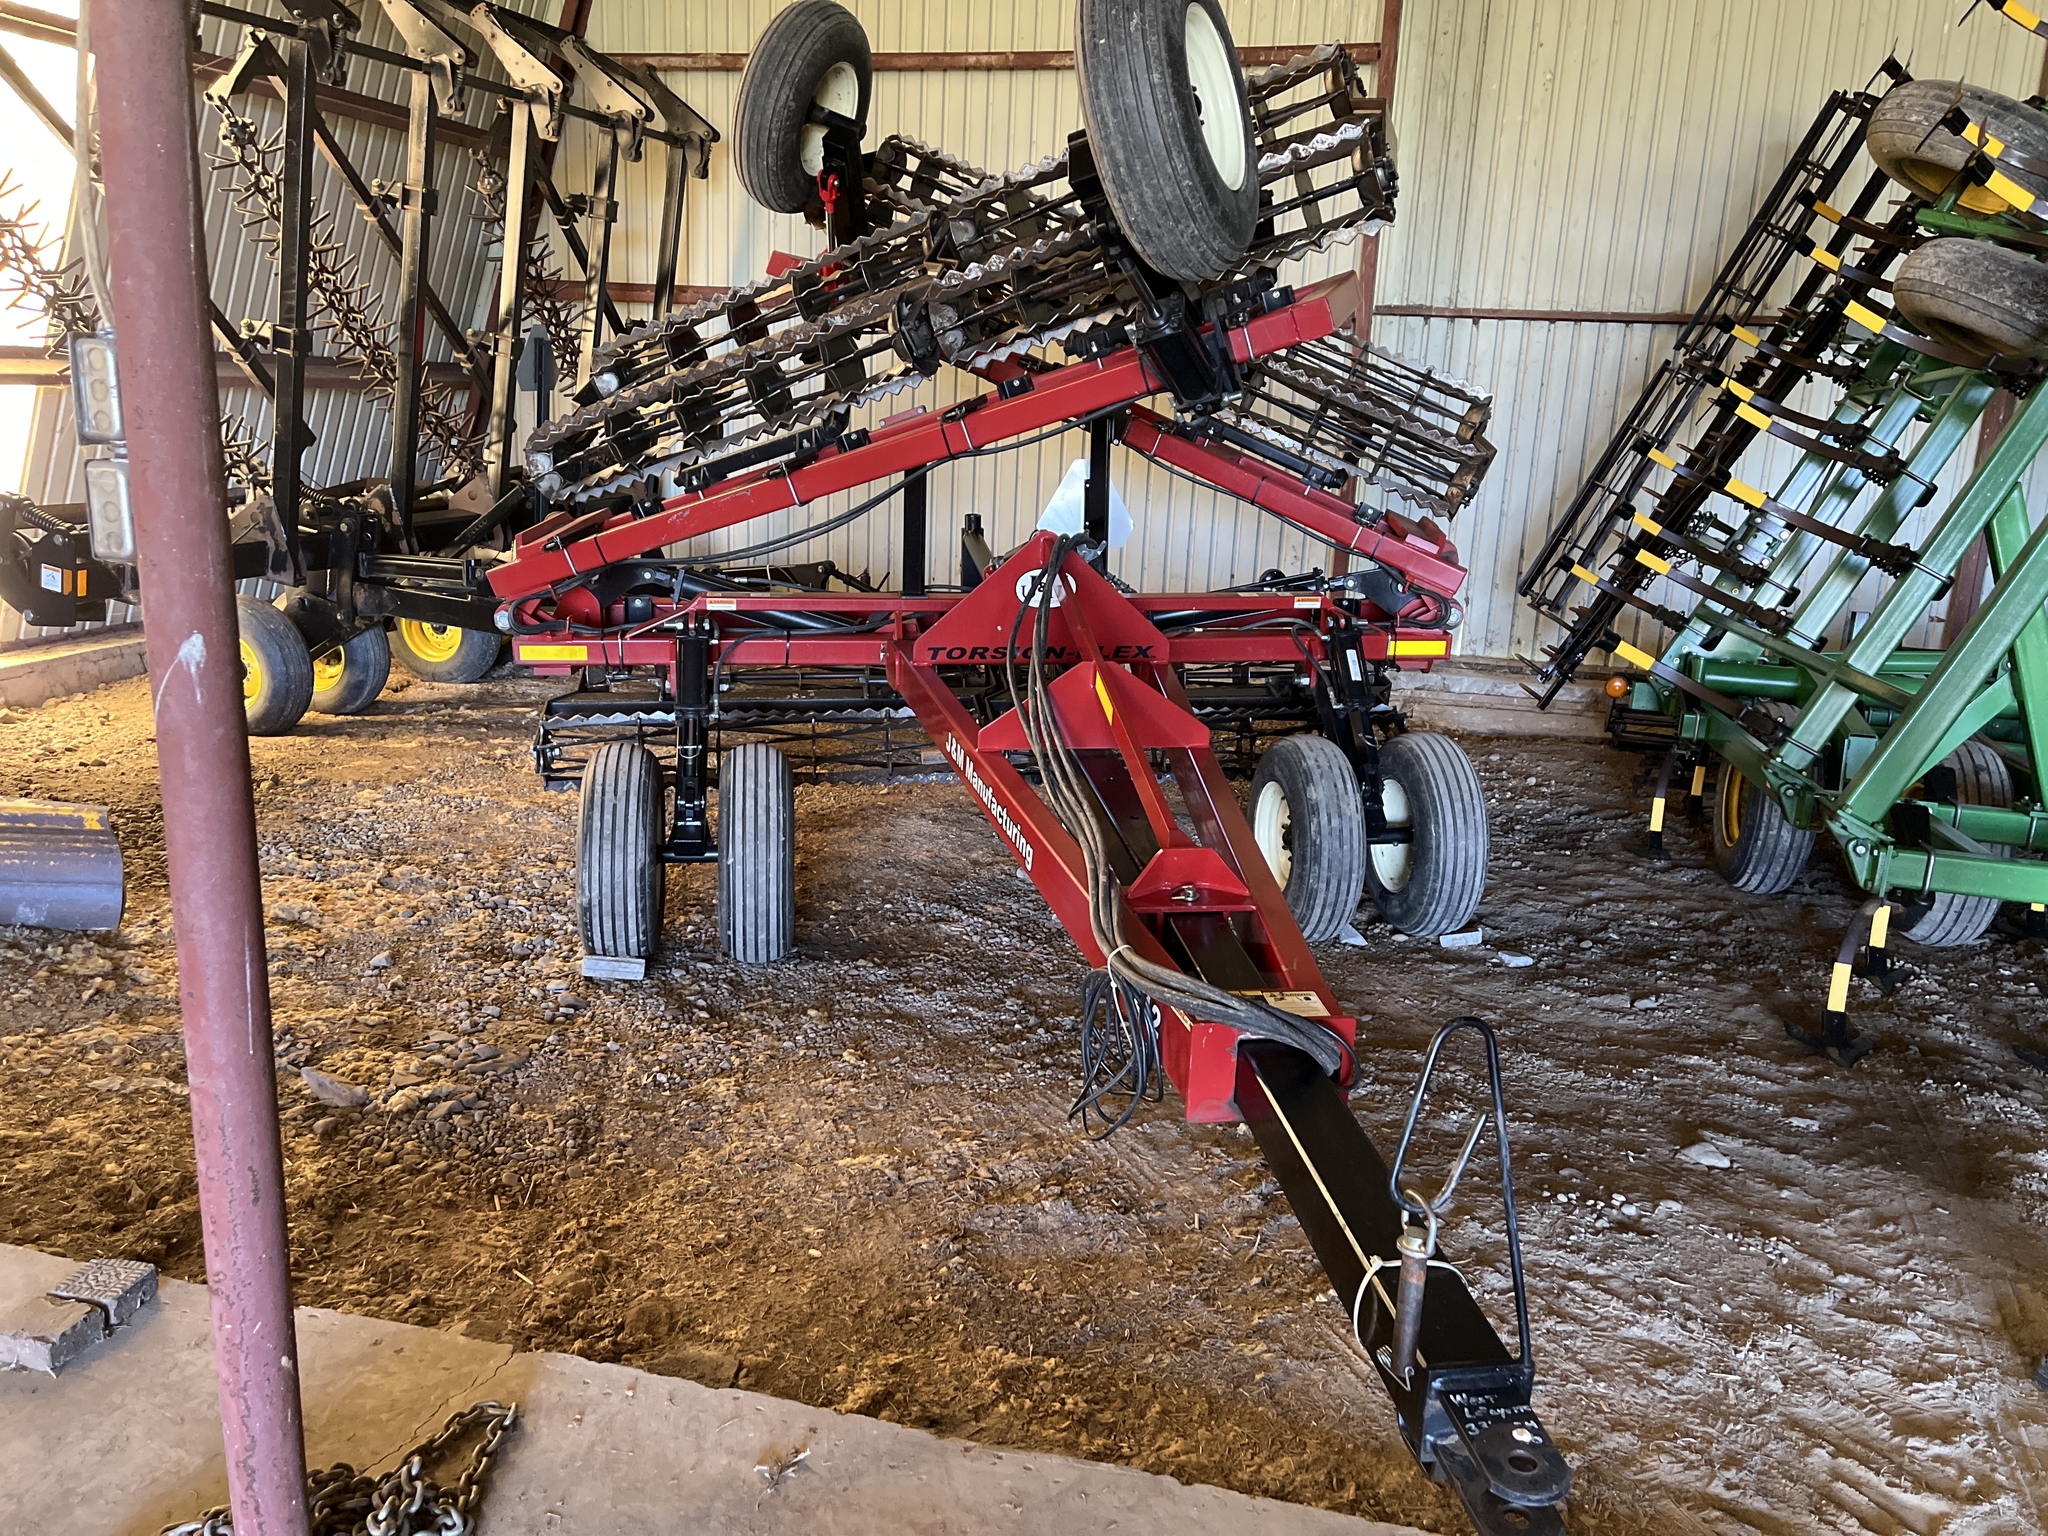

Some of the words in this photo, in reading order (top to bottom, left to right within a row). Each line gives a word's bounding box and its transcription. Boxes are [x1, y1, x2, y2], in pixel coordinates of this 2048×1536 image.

[927, 646, 1155, 661] TORSION-LEX
[945, 731, 965, 771] J&M
[965, 755, 1034, 872] Manufacturing
